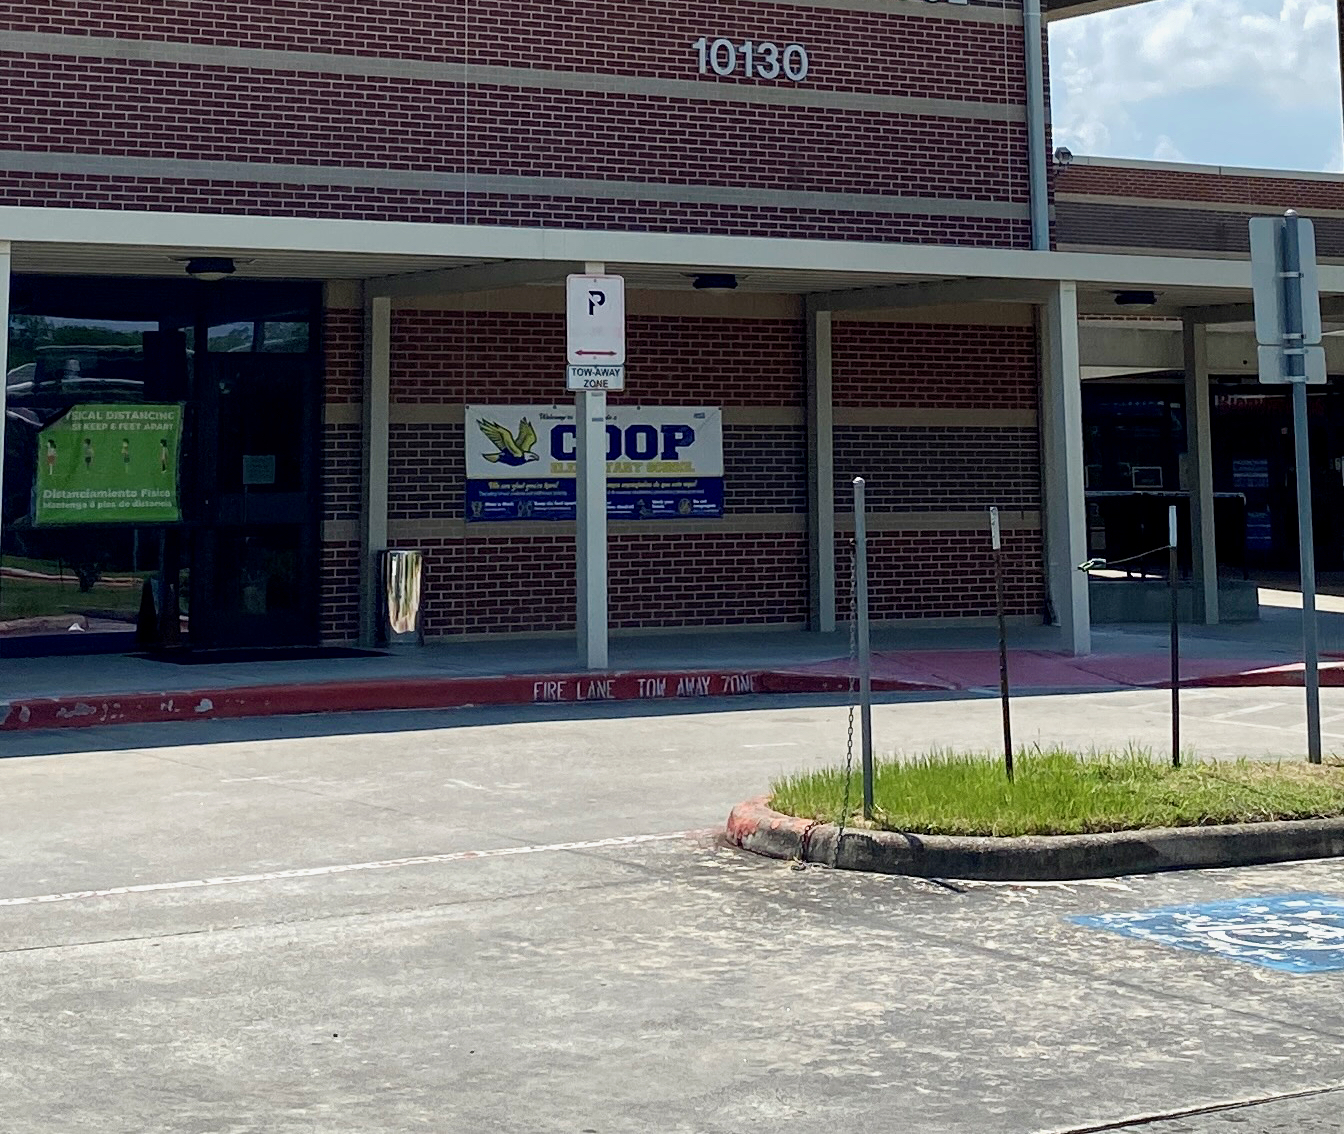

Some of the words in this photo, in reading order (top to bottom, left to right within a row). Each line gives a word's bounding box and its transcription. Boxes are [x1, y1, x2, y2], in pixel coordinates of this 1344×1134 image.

[692, 37, 809, 82] 10130
[571, 368, 621, 377] TOW-AWAY
[583, 379, 609, 388] ZONE
[107, 411, 175, 420] DISTANCING
[43, 489, 138, 499] Distanciamiento
[533, 680, 567, 701] FIRE
[577, 679, 616, 699] LANE
[637, 677, 667, 698] TOW
[676, 676, 711, 696] AWAY
[720, 674, 758, 693] ZONE
